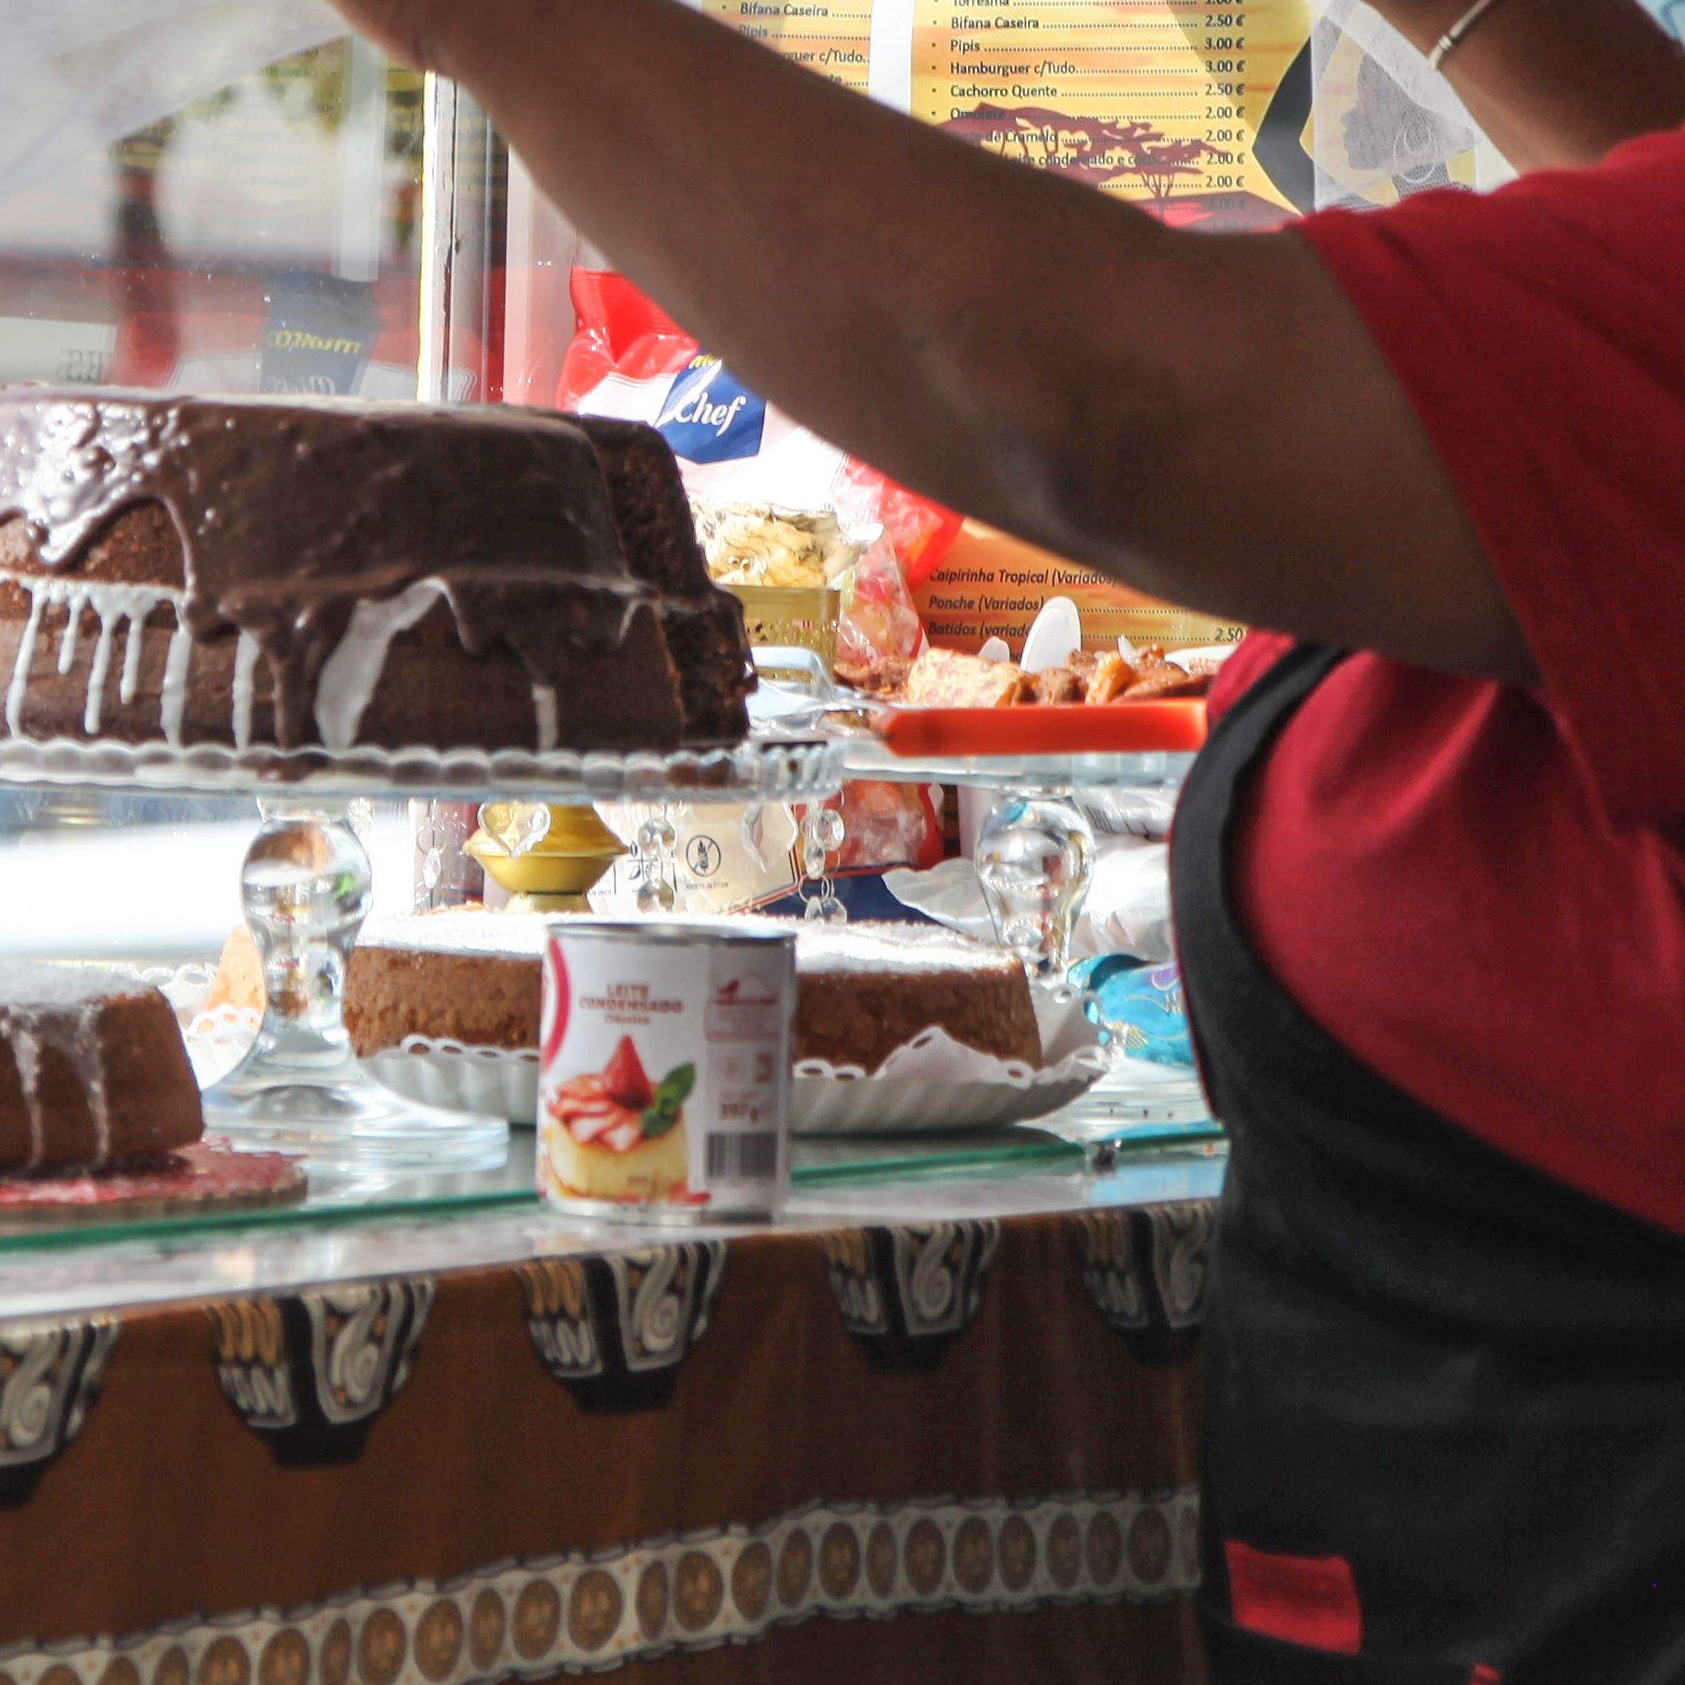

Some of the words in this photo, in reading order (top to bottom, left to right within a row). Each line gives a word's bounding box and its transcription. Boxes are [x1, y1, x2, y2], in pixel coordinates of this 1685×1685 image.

[740, 2, 780, 16] Bifana
[783, 4, 828, 17] Caseira
[951, 17, 991, 29] Bifana
[994, 17, 1039, 29] Caseira
[1204, 15, 1233, 27] 2.50
[1235, 15, 1245, 27] €
[950, 39, 980, 55] Pipis
[1204, 38, 1233, 50] 3.00
[1235, 37, 1244, 50] €
[819, 48, 862, 64] c/Tudo
[950, 62, 1030, 78] Hamburguer
[1034, 60, 1076, 77] c/Tudo
[1205, 61, 1233, 73] 3.00
[1236, 60, 1245, 73] €
[950, 85, 1008, 98] Cachorro
[1012, 85, 1057, 99] Quente
[1204, 83, 1233, 96] 2.50
[1236, 83, 1245, 96] €
[1205, 106, 1232, 119] 2.00
[1236, 106, 1245, 118] €
[1205, 129, 1232, 142] 2.00
[1236, 129, 1245, 142] €
[1206, 152, 1233, 165] 2.00
[1236, 152, 1245, 165] €
[1205, 175, 1232, 188] 2.00
[1236, 175, 1245, 188] €
[675, 392, 747, 437] Chef
[929, 569, 994, 585] Caipirinha
[999, 569, 1048, 586] Tropical
[929, 596, 974, 610] Ponche
[979, 595, 1045, 613] (Variados)
[929, 621, 976, 636] Batidos
[607, 984, 649, 998] LEITE
[580, 997, 683, 1014] CONDENSADO
